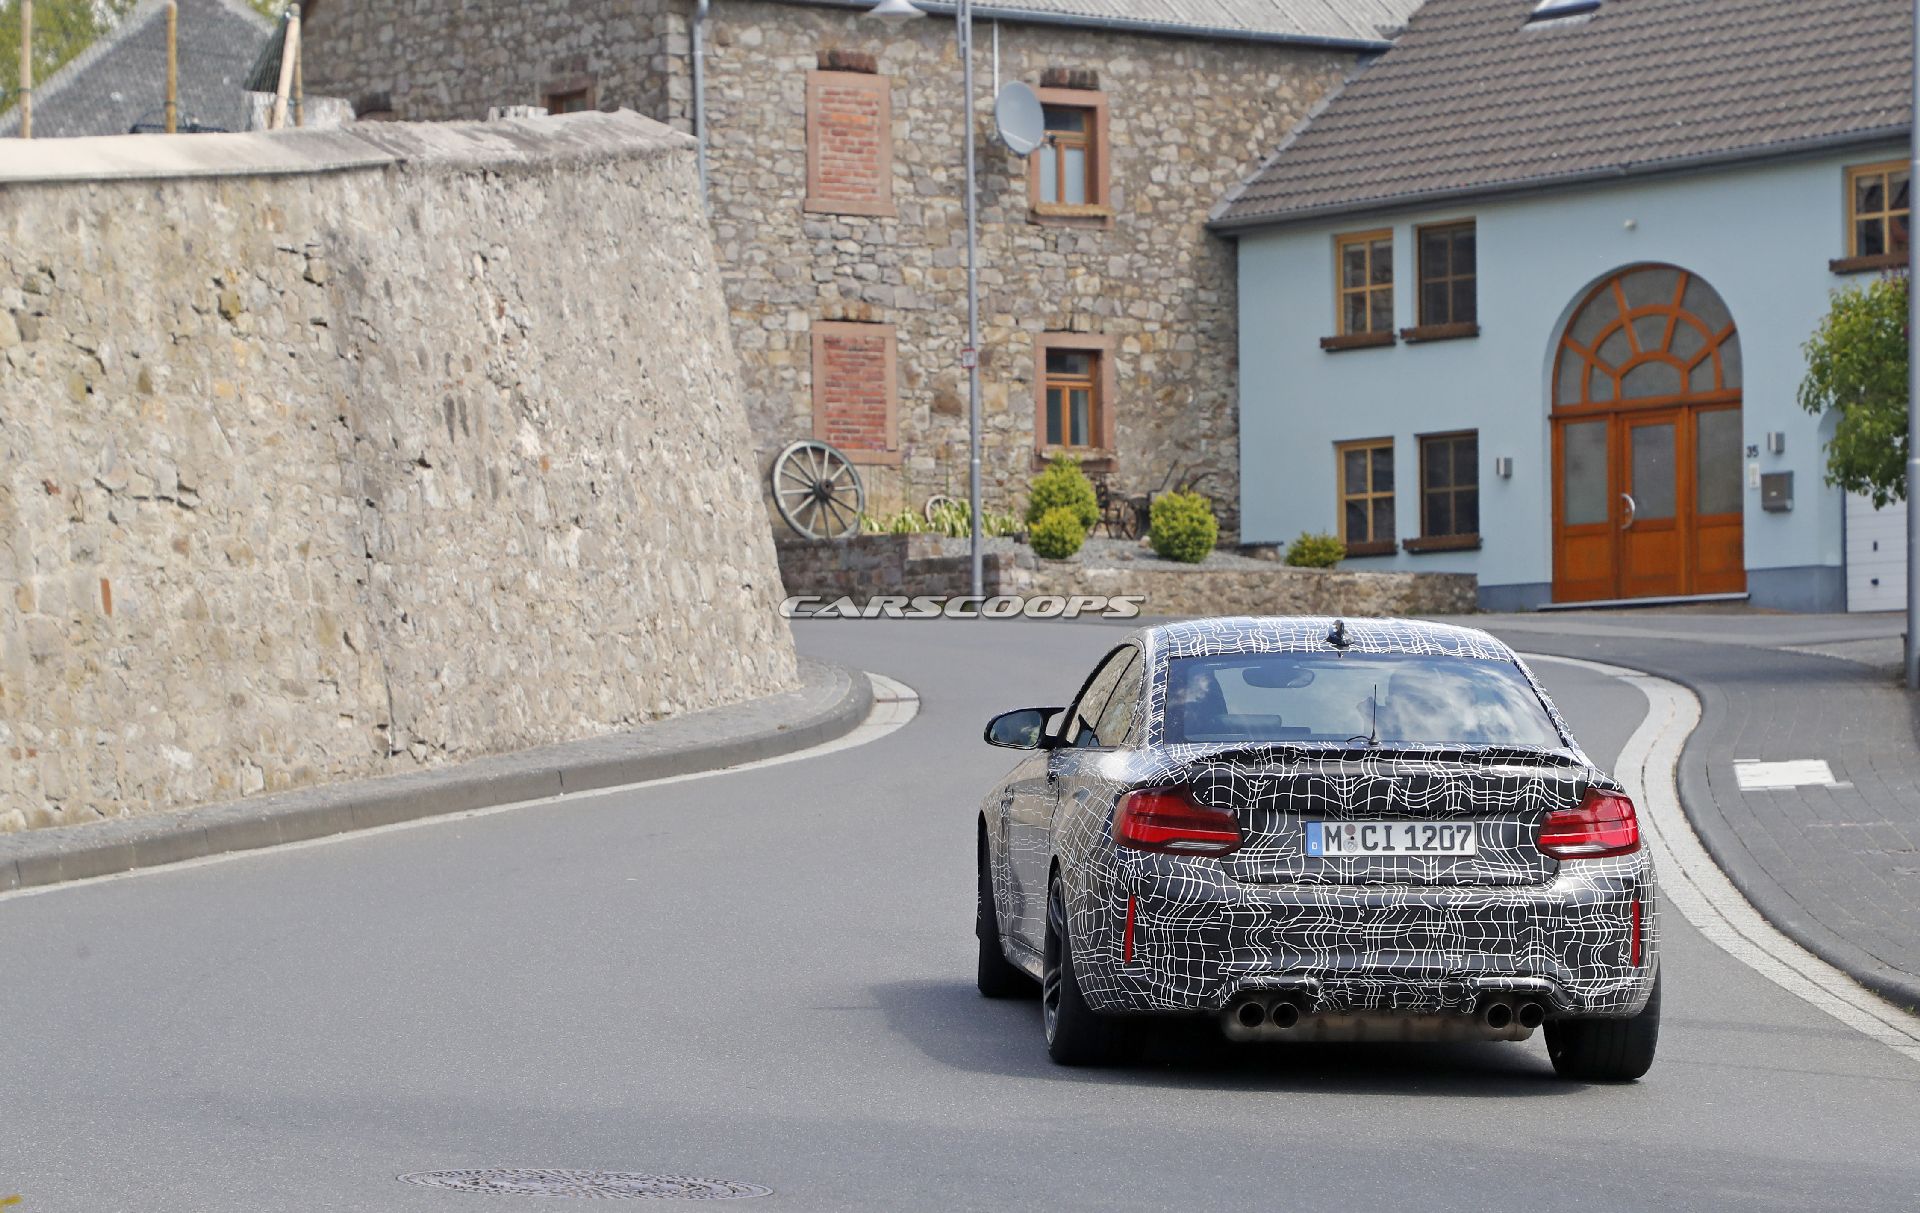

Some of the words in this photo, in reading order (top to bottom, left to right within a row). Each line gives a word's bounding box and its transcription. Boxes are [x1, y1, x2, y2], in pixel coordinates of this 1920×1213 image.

[1746, 445, 1759, 458] 35
[1325, 825, 1342, 851] M
[1361, 825, 1396, 851] CI
[1404, 825, 1472, 851] 1207
